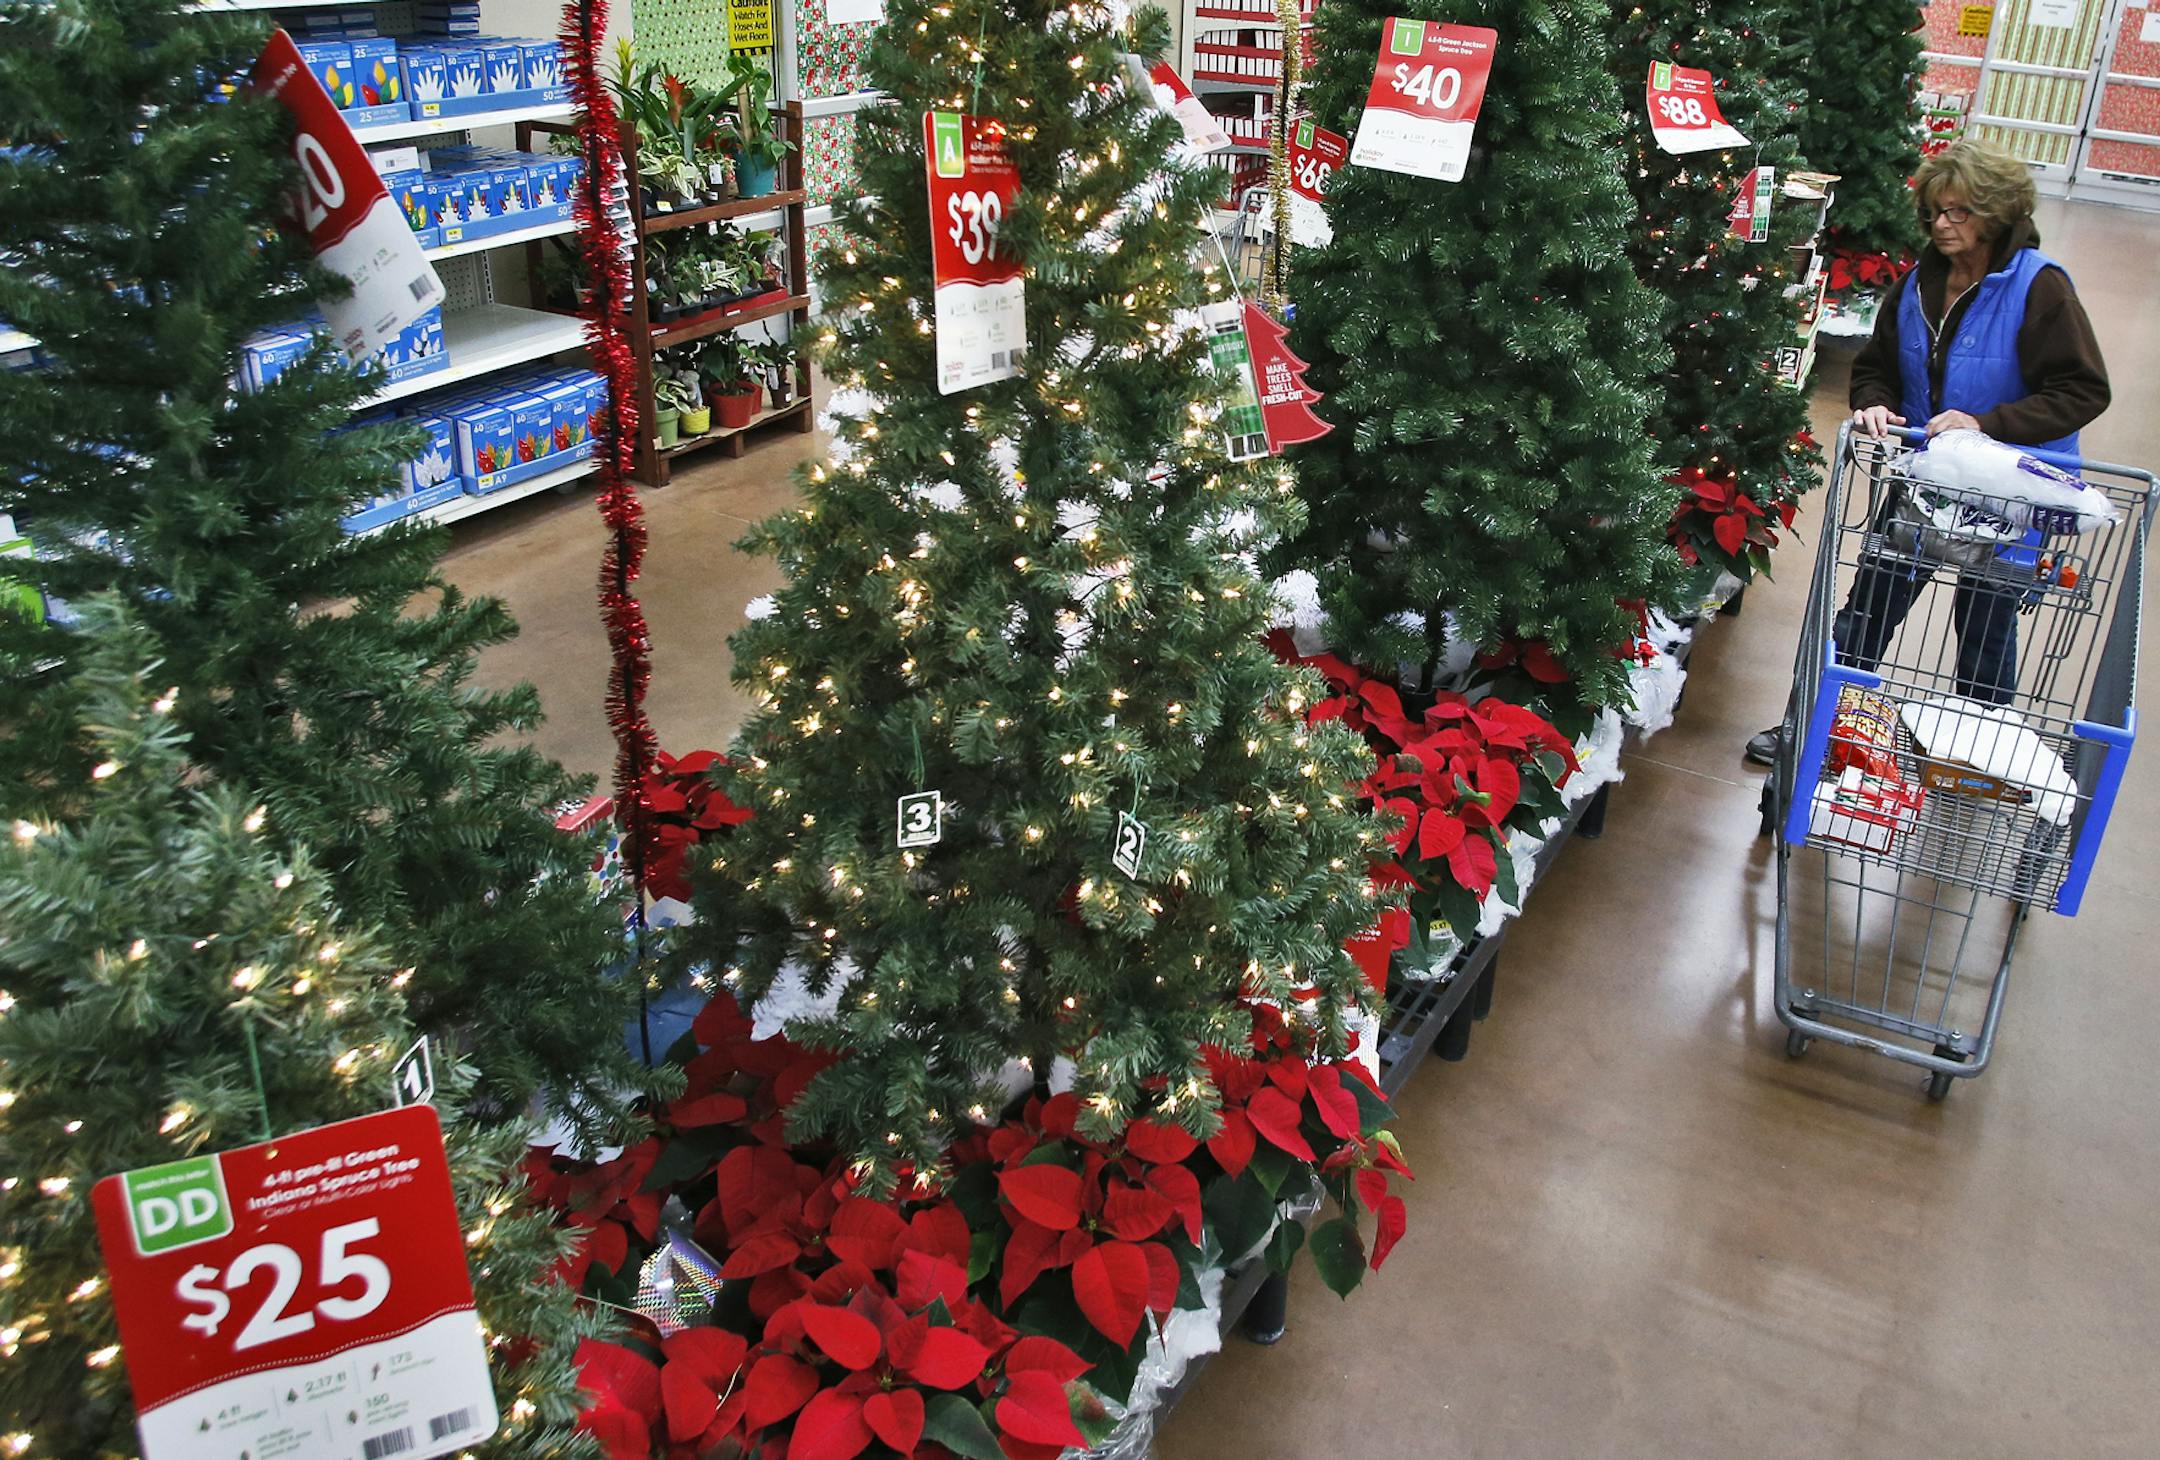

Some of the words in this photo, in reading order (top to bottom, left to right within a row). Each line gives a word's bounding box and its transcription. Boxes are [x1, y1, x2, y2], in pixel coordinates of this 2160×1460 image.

[756, 10, 767, 18] For
[1442, 37, 1462, 46] Green
[305, 54, 318, 63] 25
[354, 48, 366, 58] 25
[486, 52, 496, 62] 50
[448, 56, 458, 66] 50
[1390, 62, 1462, 110] $40
[542, 90, 554, 102] 50
[360, 111, 372, 122] 25
[1658, 96, 1707, 125] $88
[944, 136, 956, 162] A
[558, 206, 568, 217] 50
[947, 190, 1002, 265] $39
[262, 353, 274, 365] 60
[1784, 352, 1797, 367] 2
[391, 367, 404, 380] 60
[1265, 363, 1288, 375] MAKE
[1266, 372, 1292, 384] TREES
[1268, 383, 1294, 394] SMELL
[1262, 392, 1304, 406] FRESH-CUT
[474, 424, 484, 433] 60
[576, 448, 586, 458] 60
[406, 498, 418, 510] 60
[906, 802, 932, 833] 3
[1118, 826, 1138, 862] 2
[402, 1058, 422, 1098] 1
[344, 1144, 400, 1166] Green
[249, 1182, 318, 1211] Indiana
[319, 1166, 380, 1192] Spruce
[382, 1156, 421, 1176] Tree
[263, 1202, 297, 1219] Clear
[300, 1199, 312, 1210] or
[314, 1180, 378, 1206] Multi-Color
[139, 1188, 218, 1238] DD
[174, 1216, 392, 1352] $25
